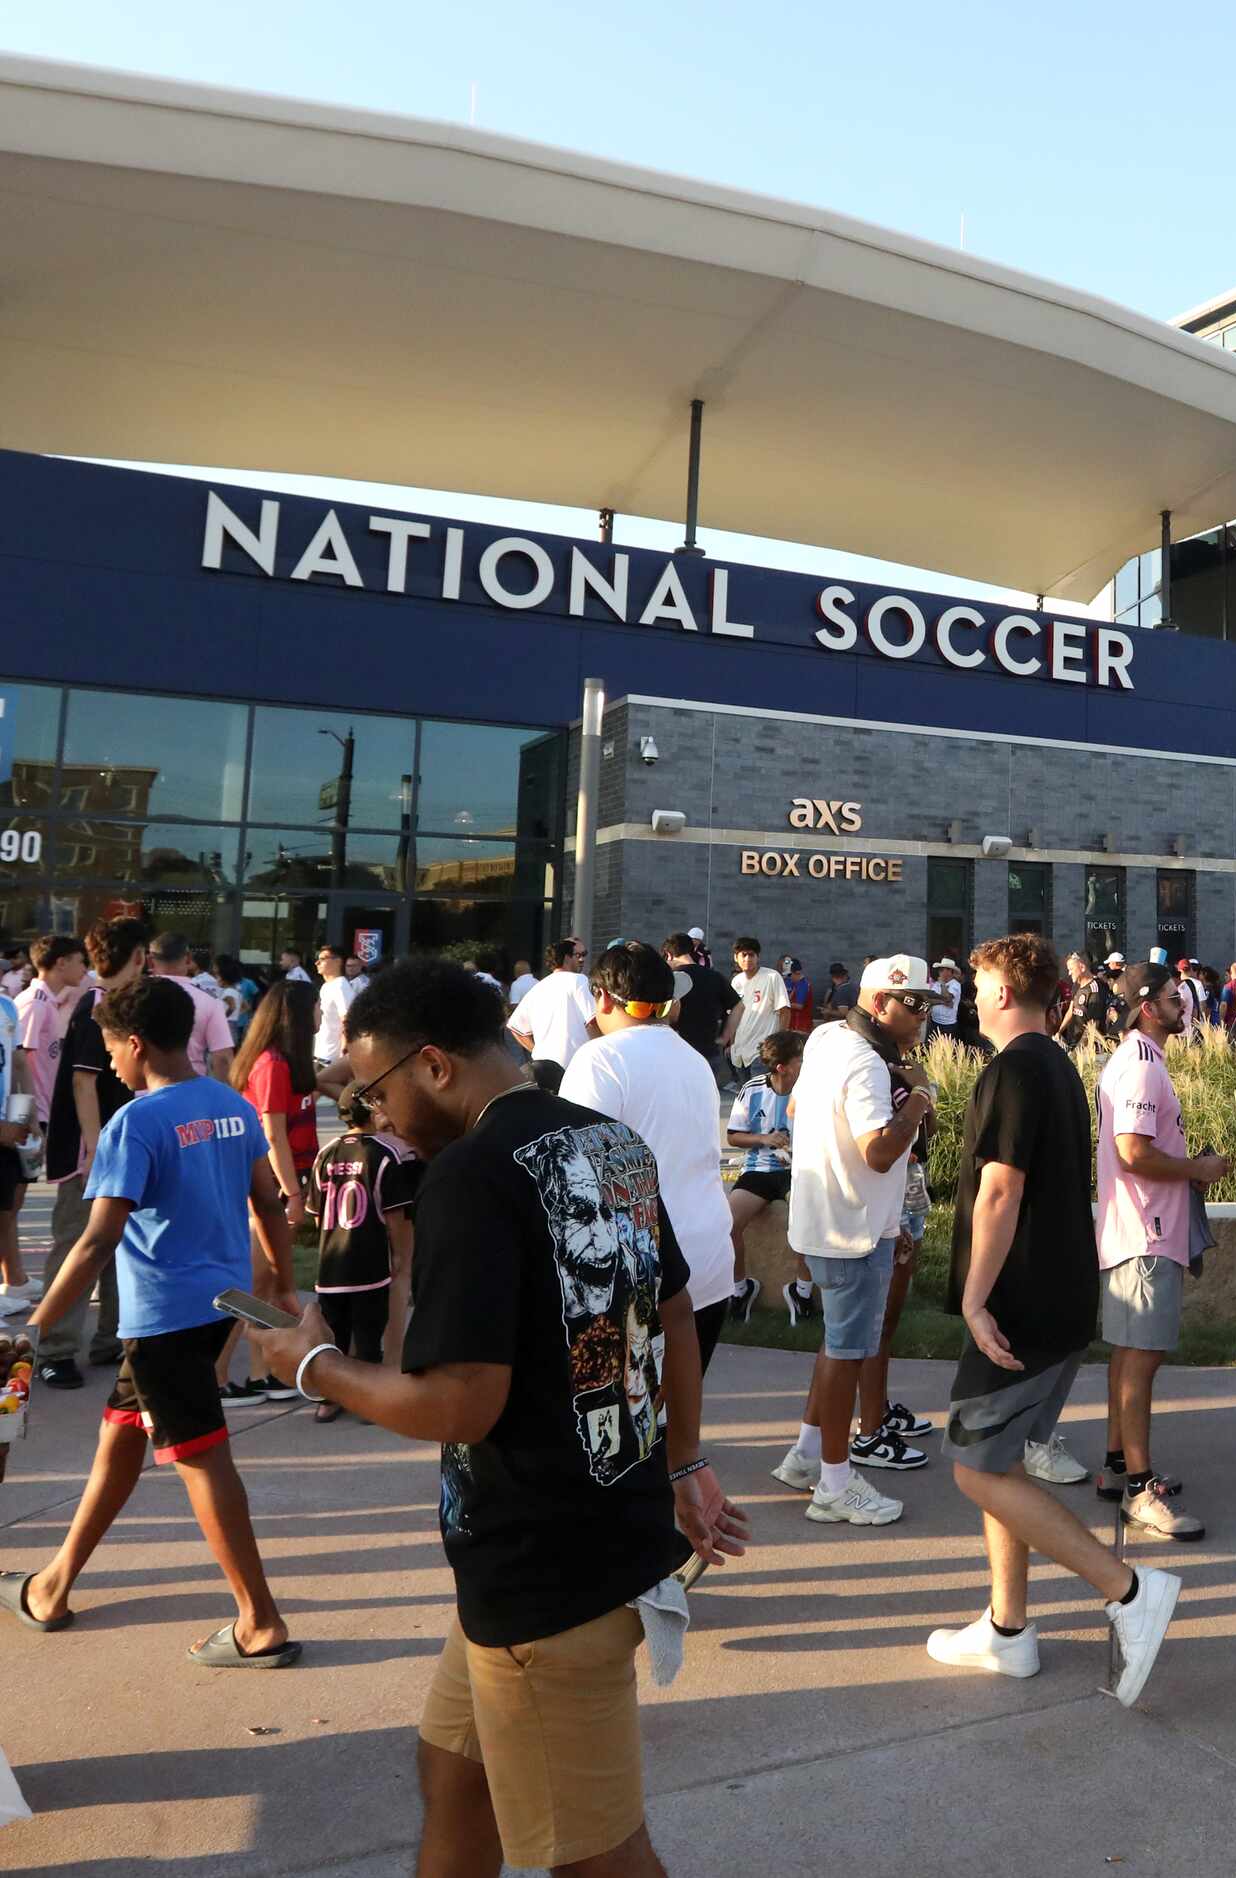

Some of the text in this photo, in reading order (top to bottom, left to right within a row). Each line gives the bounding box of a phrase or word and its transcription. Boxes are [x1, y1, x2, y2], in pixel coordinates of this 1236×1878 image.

[201, 490, 1135, 689] NATIONAL SOCCER
[741, 851, 903, 881] BOX OFFICE
[1087, 921, 1117, 930] TICKETS
[1158, 923, 1186, 932] TICKETS
[1125, 1099, 1156, 1112] Fracht
[326, 1162, 363, 1176] MESSI
[320, 1180, 368, 1231] 10
